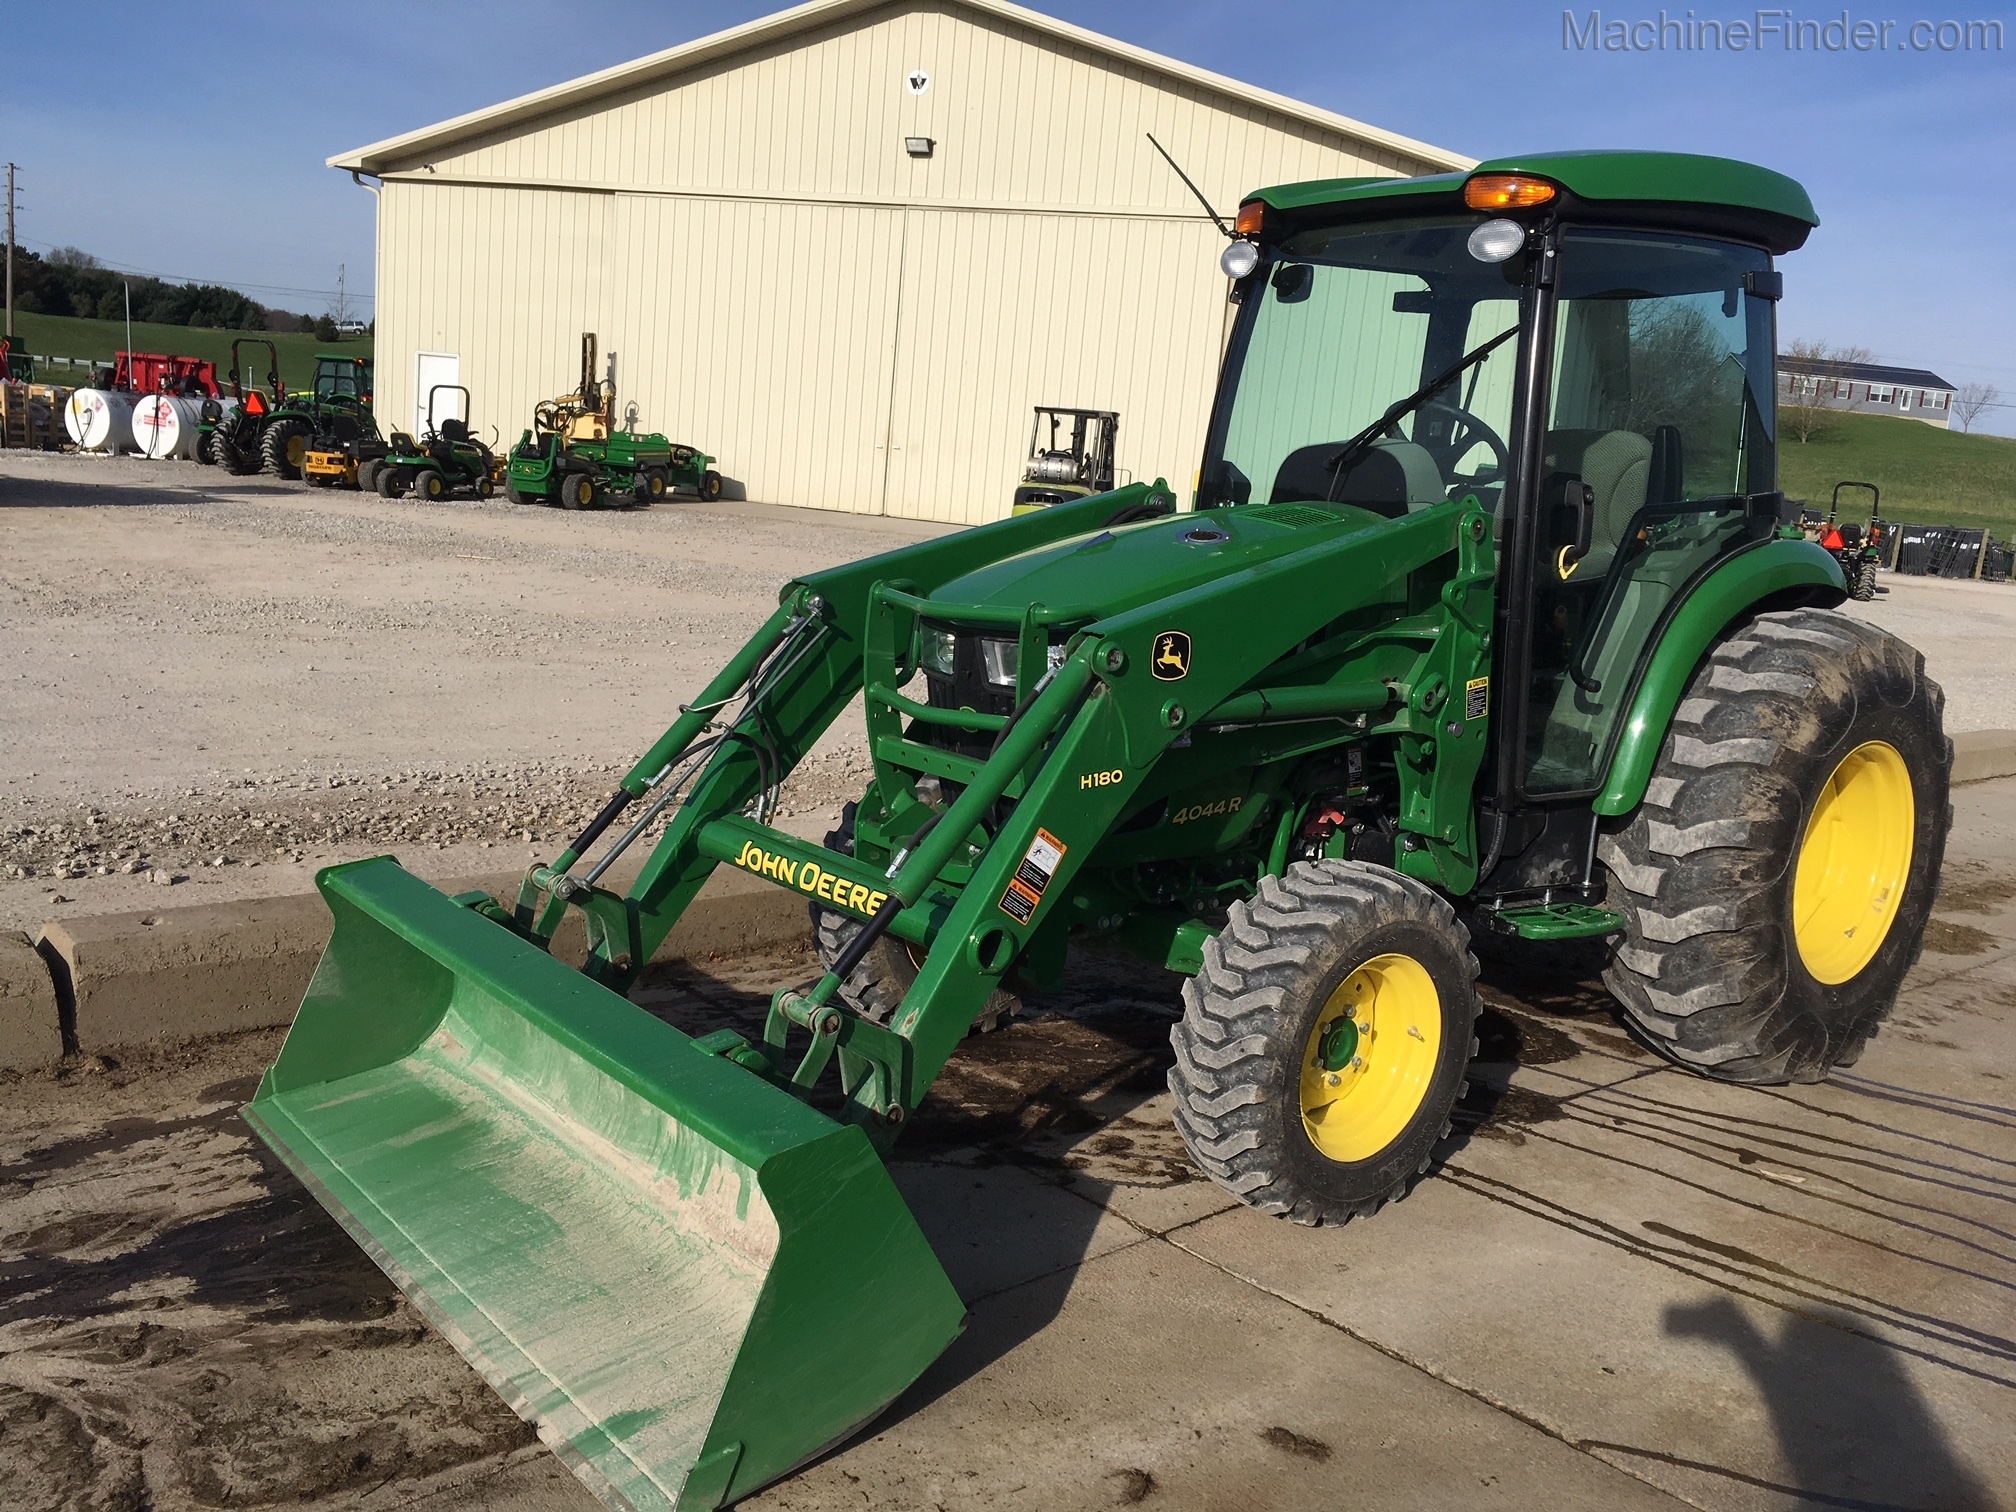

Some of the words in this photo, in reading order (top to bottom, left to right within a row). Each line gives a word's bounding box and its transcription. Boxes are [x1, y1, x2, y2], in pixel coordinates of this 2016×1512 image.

[1080, 769, 1123, 790] H180
[1172, 796, 1242, 825] 4044R
[1045, 834, 1064, 851] WARNING
[734, 840, 798, 885] JOHN
[799, 861, 888, 917] DEERE
[1017, 886, 1037, 903] WARNING
